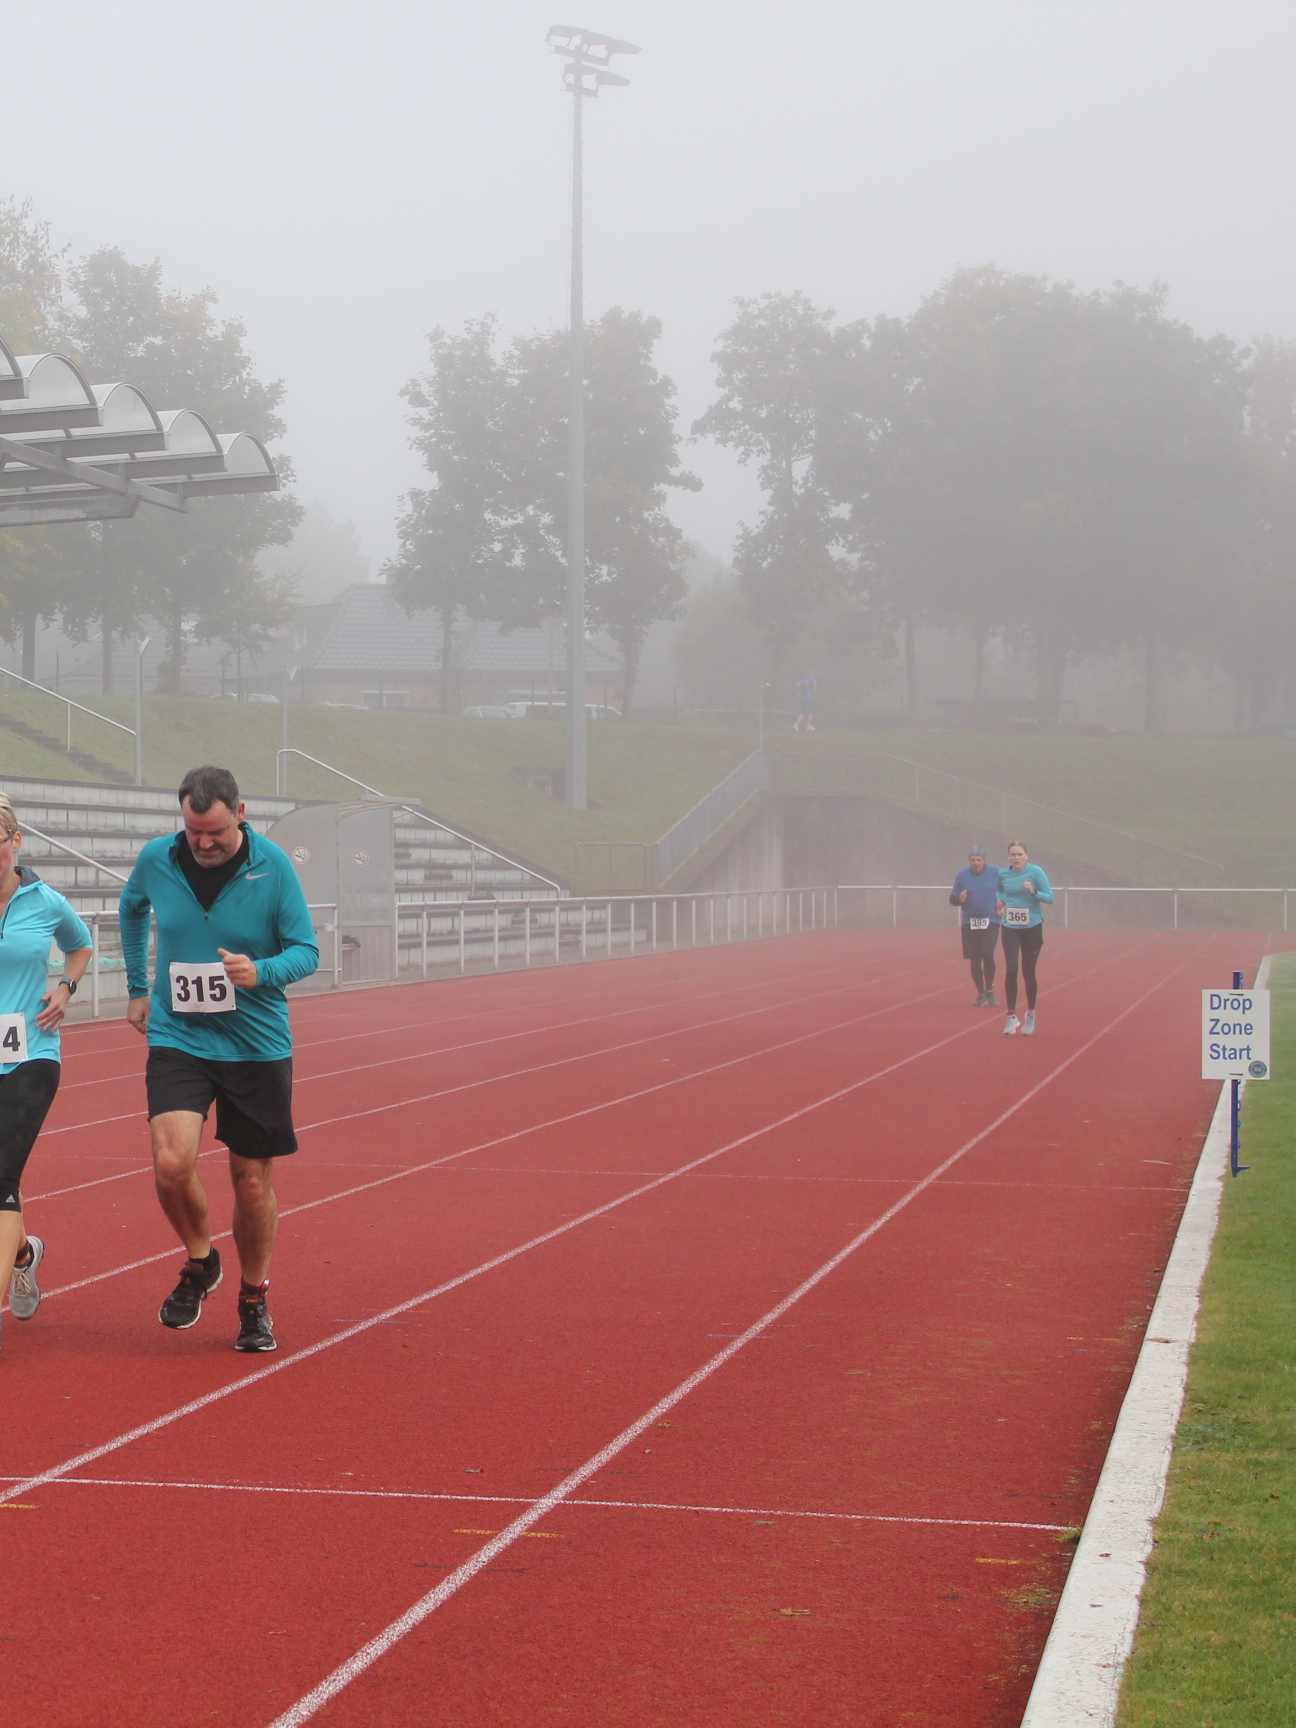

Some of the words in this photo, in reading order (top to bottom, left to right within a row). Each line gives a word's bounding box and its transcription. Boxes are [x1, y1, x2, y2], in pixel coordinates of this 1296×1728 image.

[176, 975, 227, 1003] 315
[1209, 993, 1253, 1014] Drop
[1208, 1018, 1254, 1035] Zone
[1209, 1043, 1252, 1060] Start
